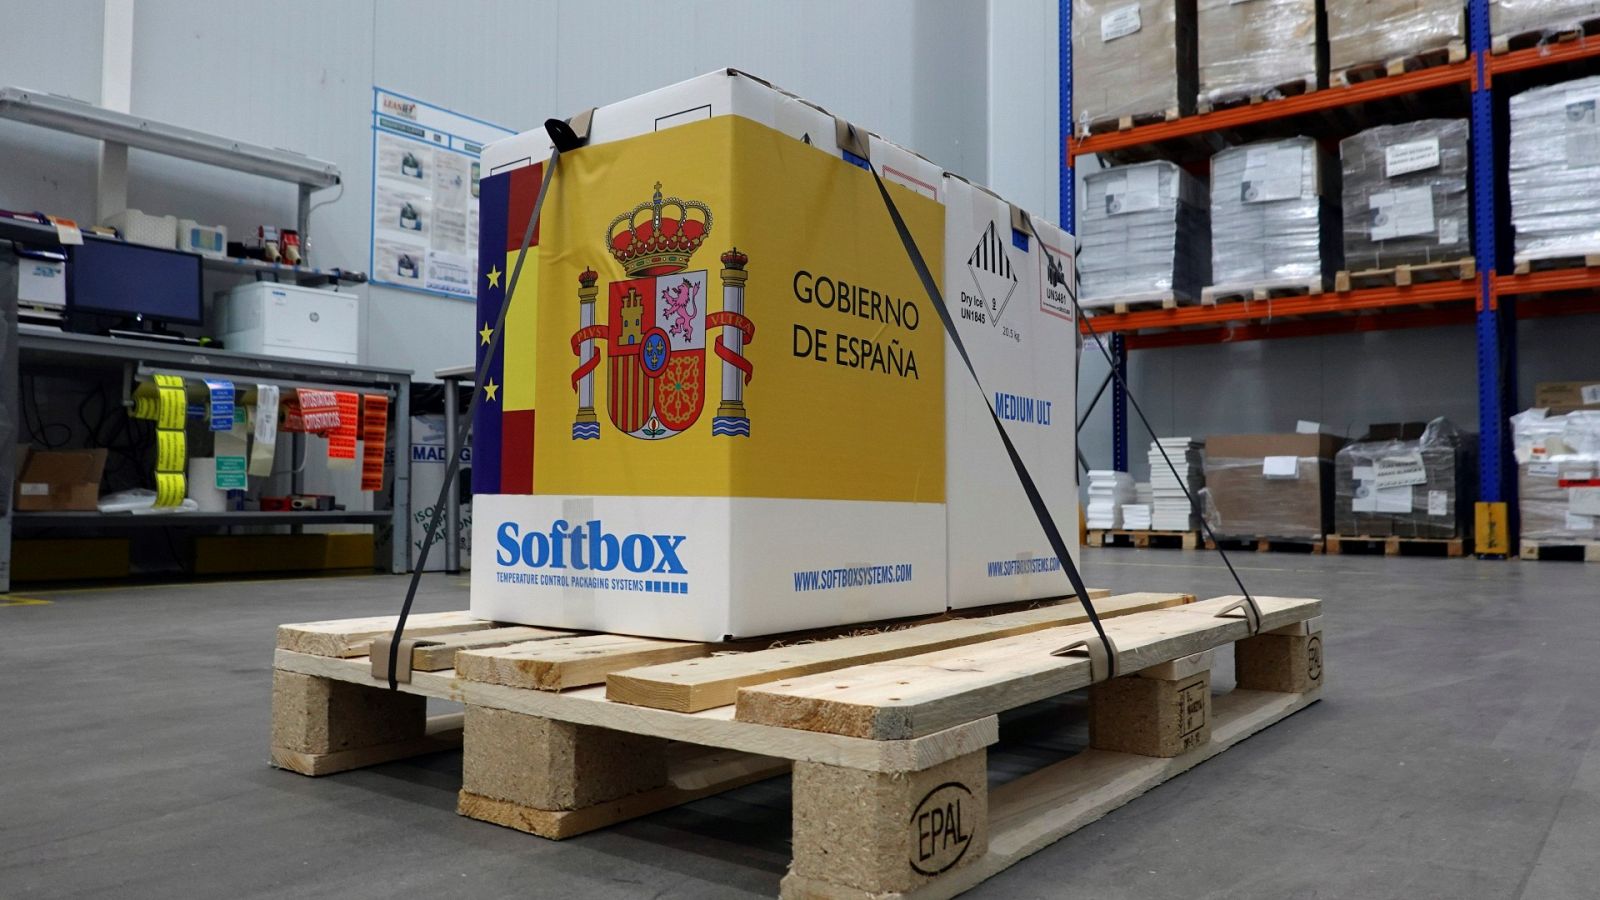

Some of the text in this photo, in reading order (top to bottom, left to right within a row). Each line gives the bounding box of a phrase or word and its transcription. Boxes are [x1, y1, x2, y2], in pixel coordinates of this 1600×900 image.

[793, 270, 919, 331] GOBIERNO
[961, 291, 983, 308] Dry Ice
[961, 307, 986, 324] UN1845
[793, 323, 919, 380] DE ESPAÑA
[995, 391, 1052, 425] MEDIUM ULT
[496, 519, 688, 574] Softbox
[496, 572, 644, 592] TEMPERATURE CONTROL PACKAGING SYSTEMS
[794, 563, 912, 592] WWW.SOFTBOXSYSTEMS.COM
[918, 799, 968, 861] EPAL
